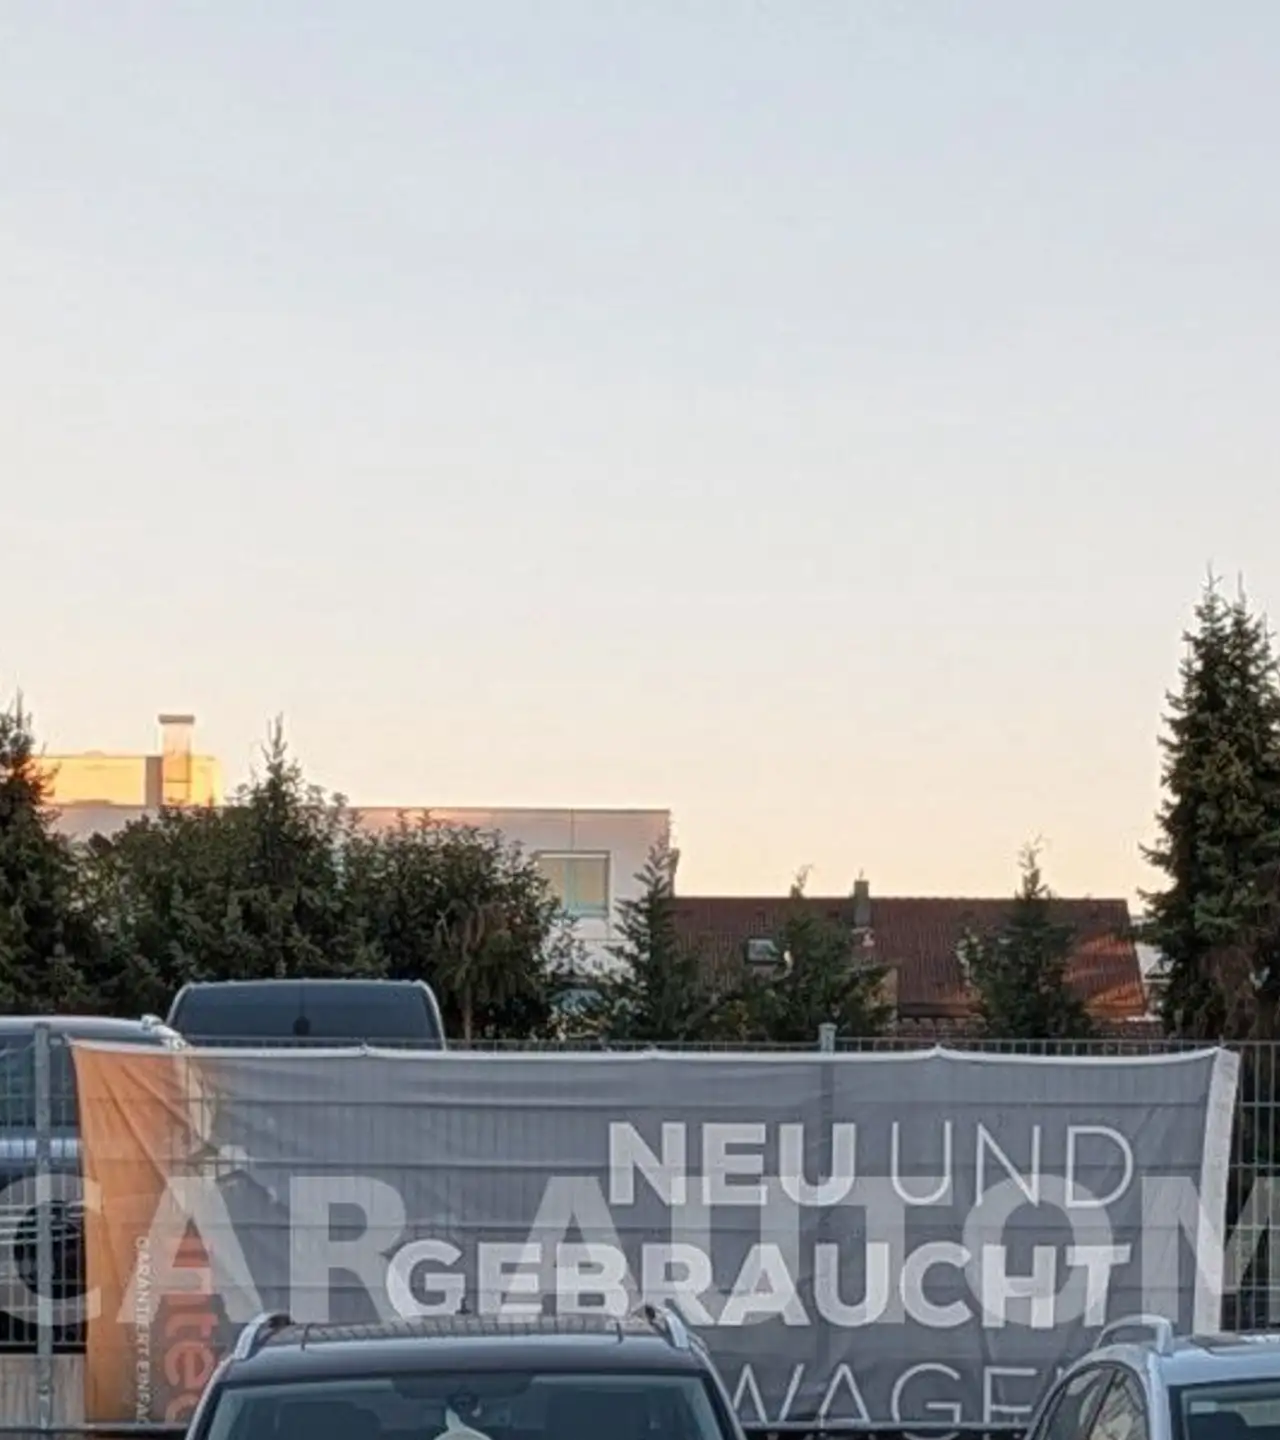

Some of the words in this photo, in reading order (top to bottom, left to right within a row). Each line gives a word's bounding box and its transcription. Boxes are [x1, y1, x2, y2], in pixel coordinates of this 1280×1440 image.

[608, 1120, 858, 1207] NEU
[891, 1120, 1134, 1209] UND
[385, 1239, 1131, 1330] GEBRAUCHT
